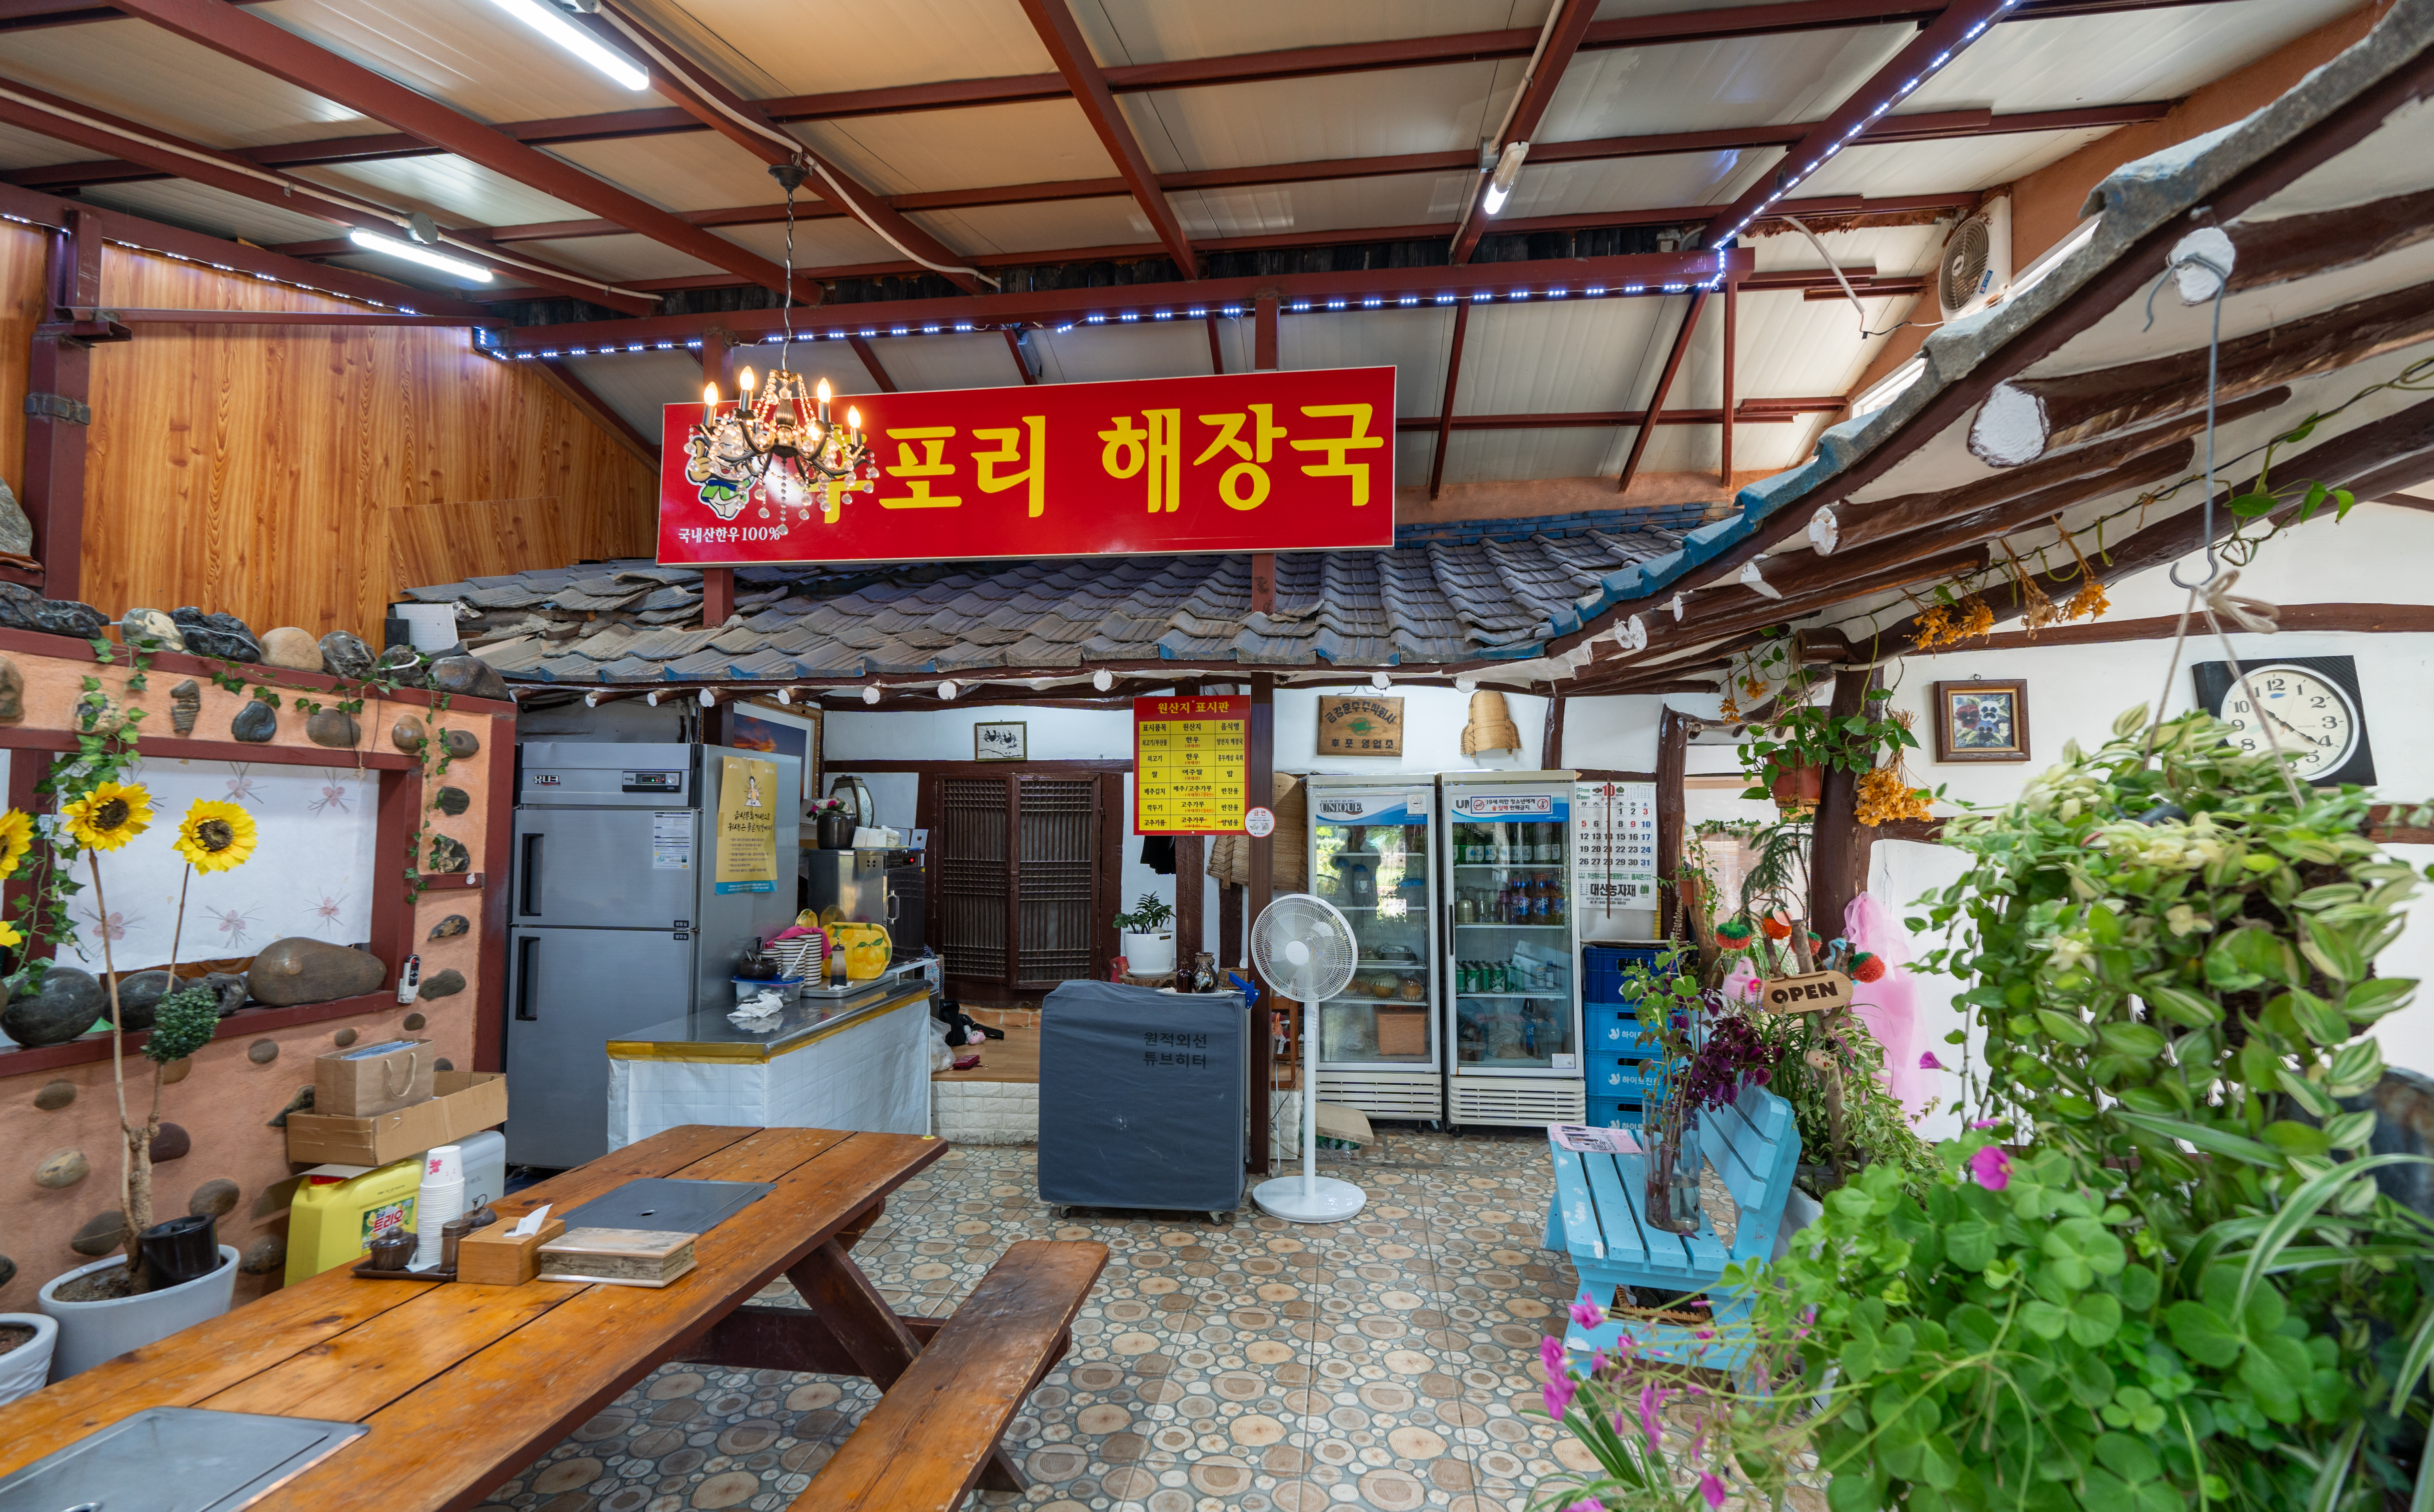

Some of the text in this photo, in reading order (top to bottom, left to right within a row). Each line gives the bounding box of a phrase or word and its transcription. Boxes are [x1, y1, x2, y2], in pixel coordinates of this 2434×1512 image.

[1101, 402, 1384, 513] 해장국
[2265, 678, 2286, 691] 12
[2296, 684, 2303, 695] 1
[1157, 701, 1230, 714] 원산지 표시판
[2234, 700, 2250, 713] 10
[2310, 696, 2327, 709] 2
[1143, 724, 1167, 732] 표시품목
[1221, 722, 1240, 731] 음식명
[2231, 719, 2245, 731] 9
[2322, 716, 2337, 729] 3
[1362, 739, 1393, 748] 영업소
[2241, 739, 2256, 751] 8
[2317, 735, 2333, 747] 4
[533, 775, 560, 785] 유니크
[1602, 785, 1615, 796] 10
[1320, 803, 1363, 814] UNIQUE
[1590, 883, 1636, 897] 대신농자재
[1771, 981, 1839, 1004] OPEN
[1144, 1032, 1207, 1049] 원적외선
[1143, 1051, 1207, 1069] 튜브히터
[373, 1210, 403, 1232] 트리오
